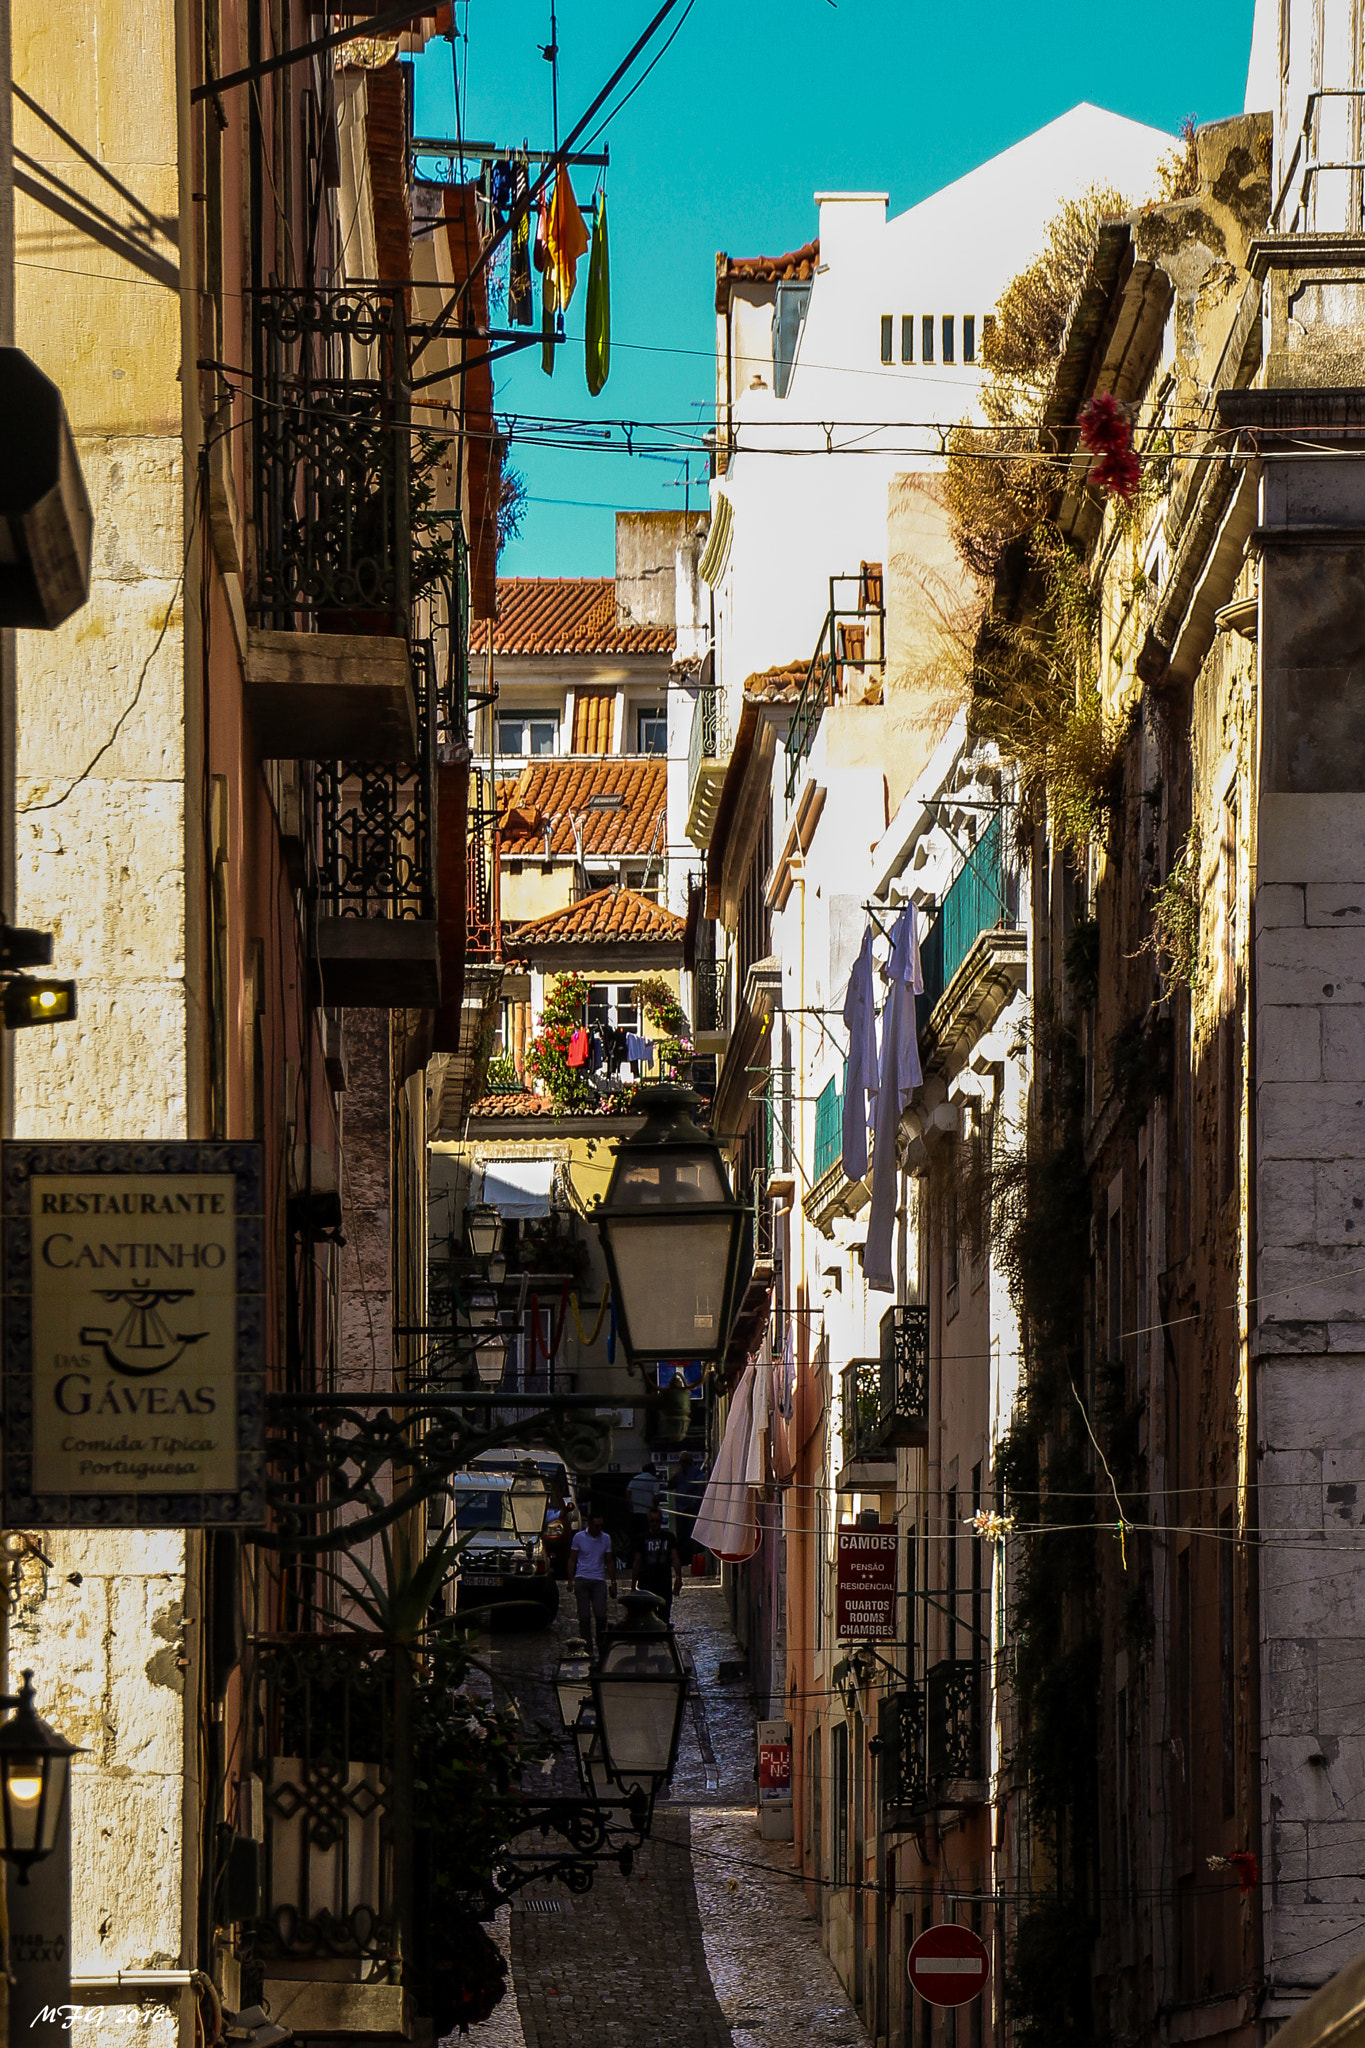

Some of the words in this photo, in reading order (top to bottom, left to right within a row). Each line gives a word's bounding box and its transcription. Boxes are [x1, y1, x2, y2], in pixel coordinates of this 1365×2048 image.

[41, 1193, 226, 1215] RESTAURANTE
[42, 1232, 226, 1269] CANTINHO
[54, 1353, 92, 1368] DAS
[54, 1373, 216, 1416] GÁVEAS
[61, 1435, 146, 1453] Comida
[79, 1459, 199, 1480] Portuguesa
[850, 1561, 885, 1571] PENSÃO
[840, 1583, 894, 1591] RESIDENCIAL
[845, 1600, 890, 1611] QUARTOS
[849, 1612, 885, 1623] ROOMS
[840, 1624, 894, 1636] CHAMBRES
